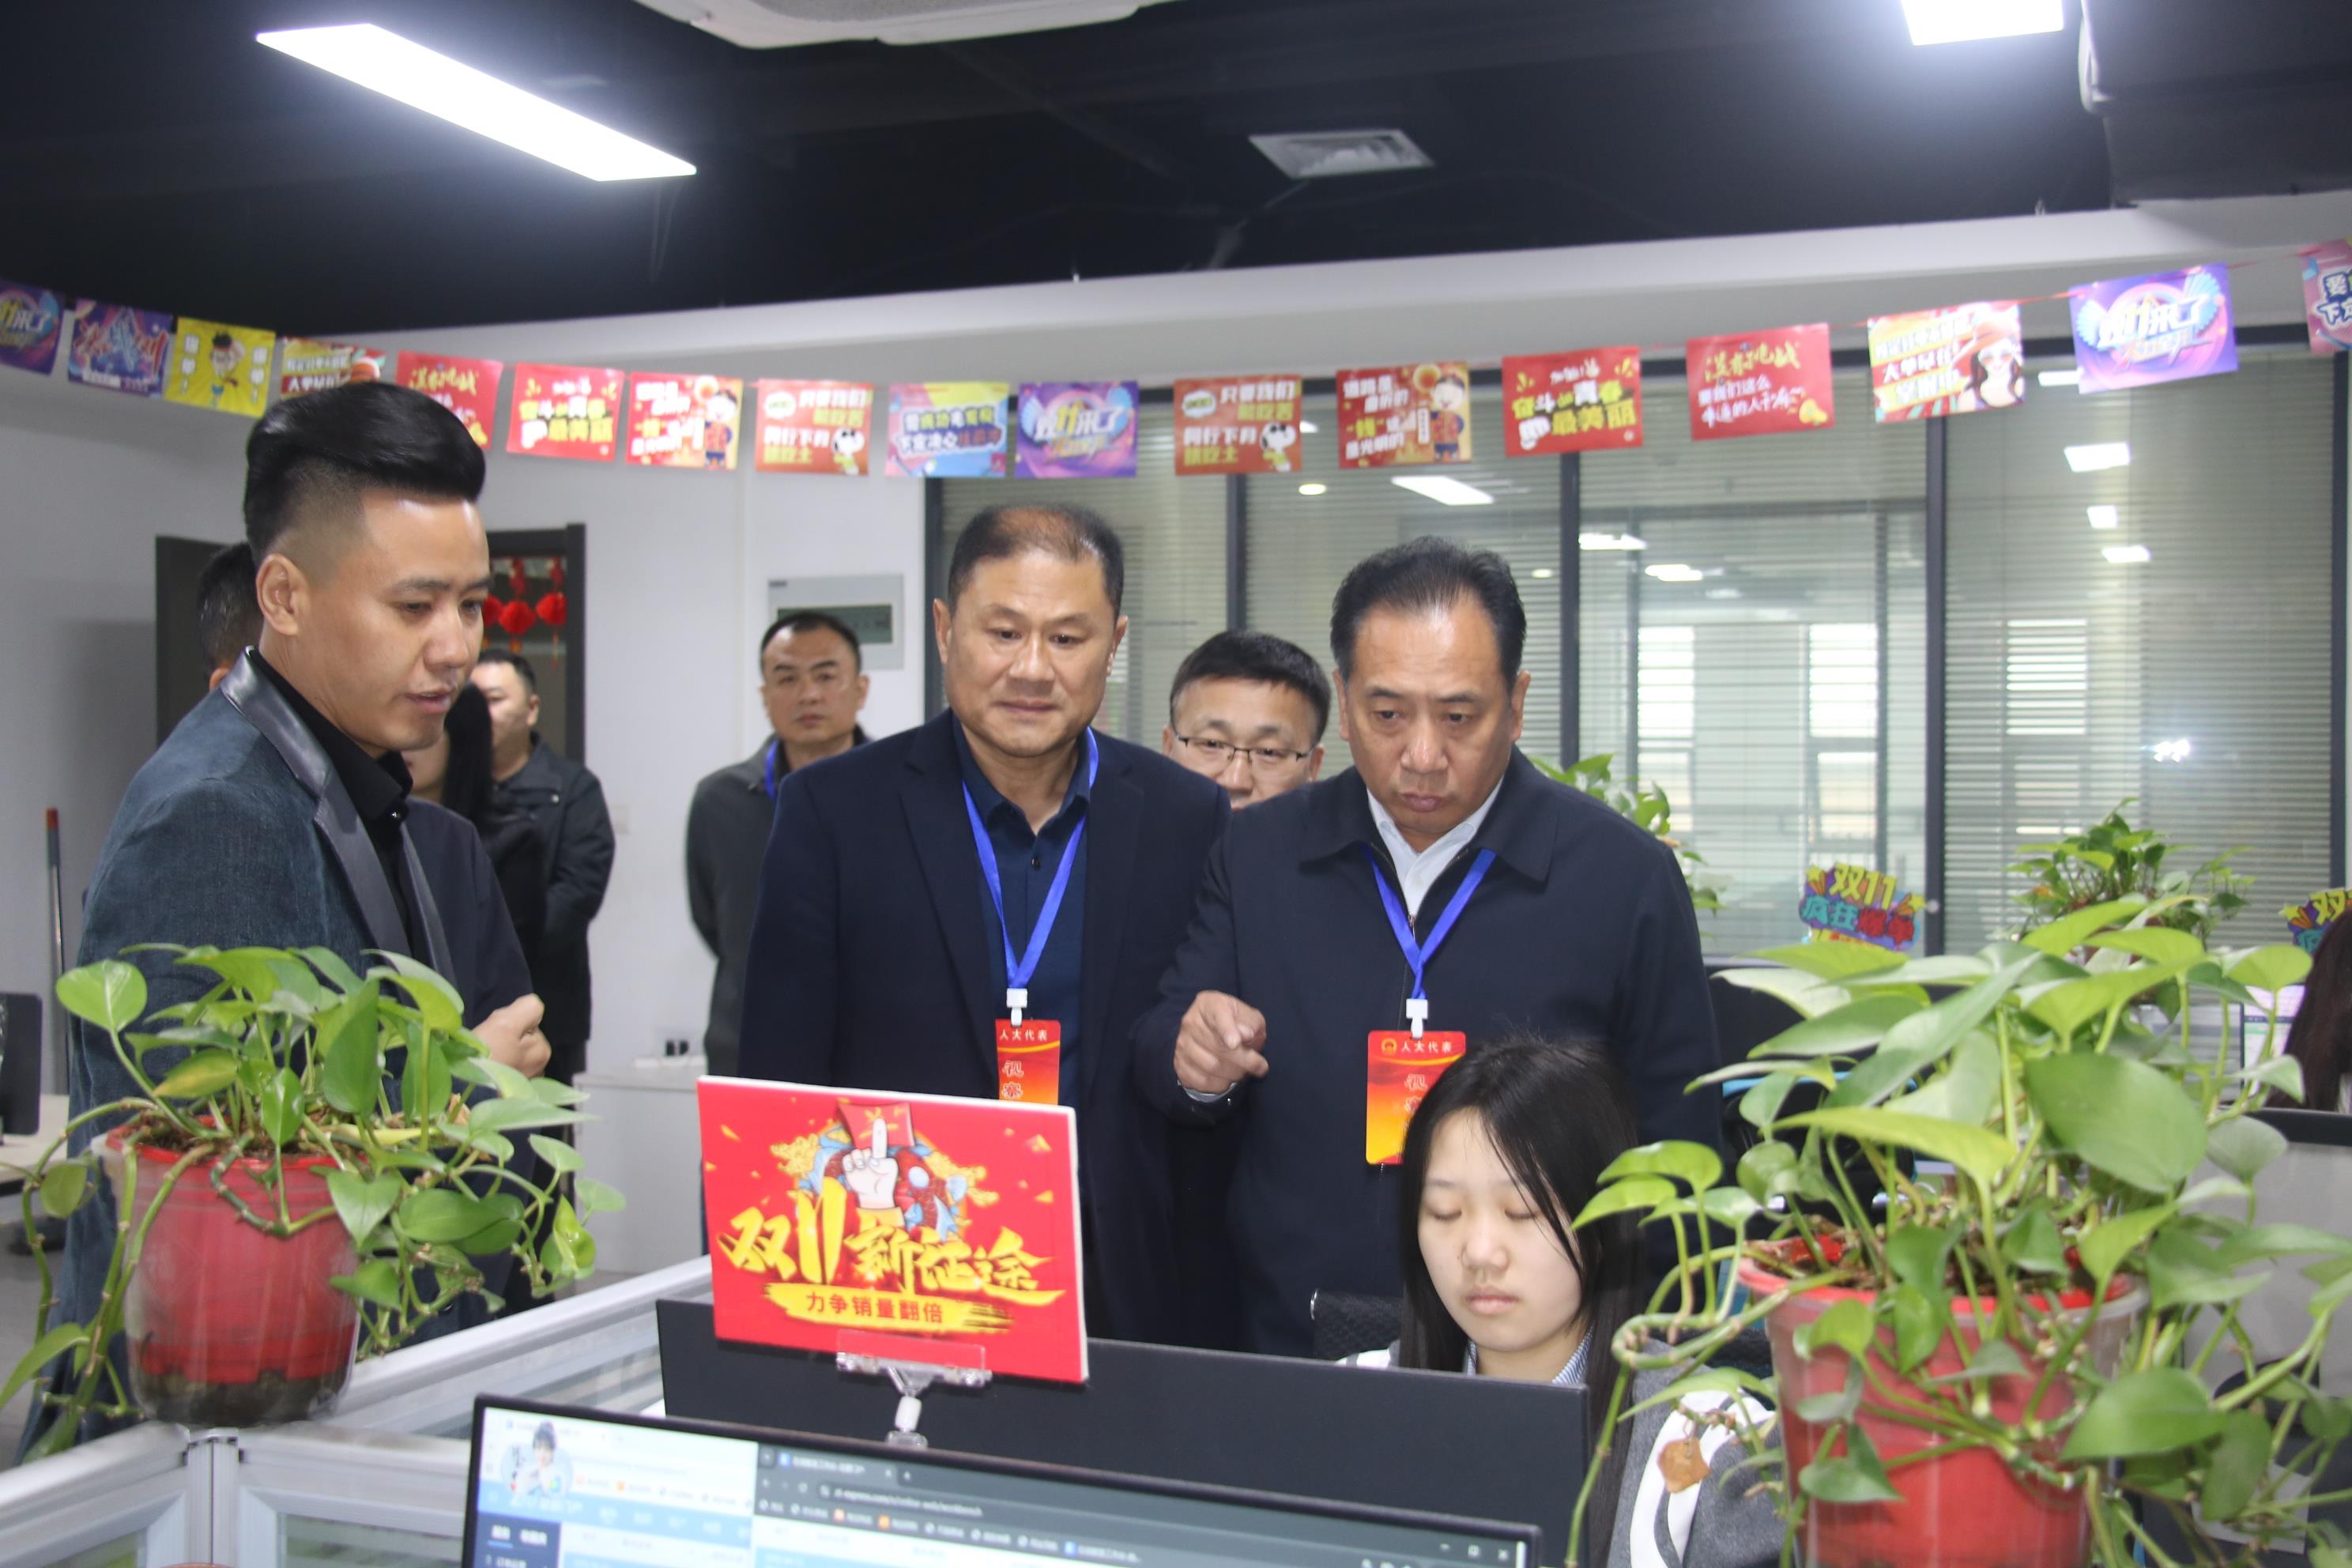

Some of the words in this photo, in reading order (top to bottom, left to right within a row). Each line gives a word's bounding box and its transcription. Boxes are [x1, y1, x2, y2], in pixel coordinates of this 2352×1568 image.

[1829, 862, 1897, 910] 双11
[999, 1028, 1048, 1042] 人大代表
[1400, 1040, 1452, 1054] 人大代表
[718, 1178, 1066, 1306] 双11新征途
[806, 1291, 943, 1324] 力争销量翻倍
